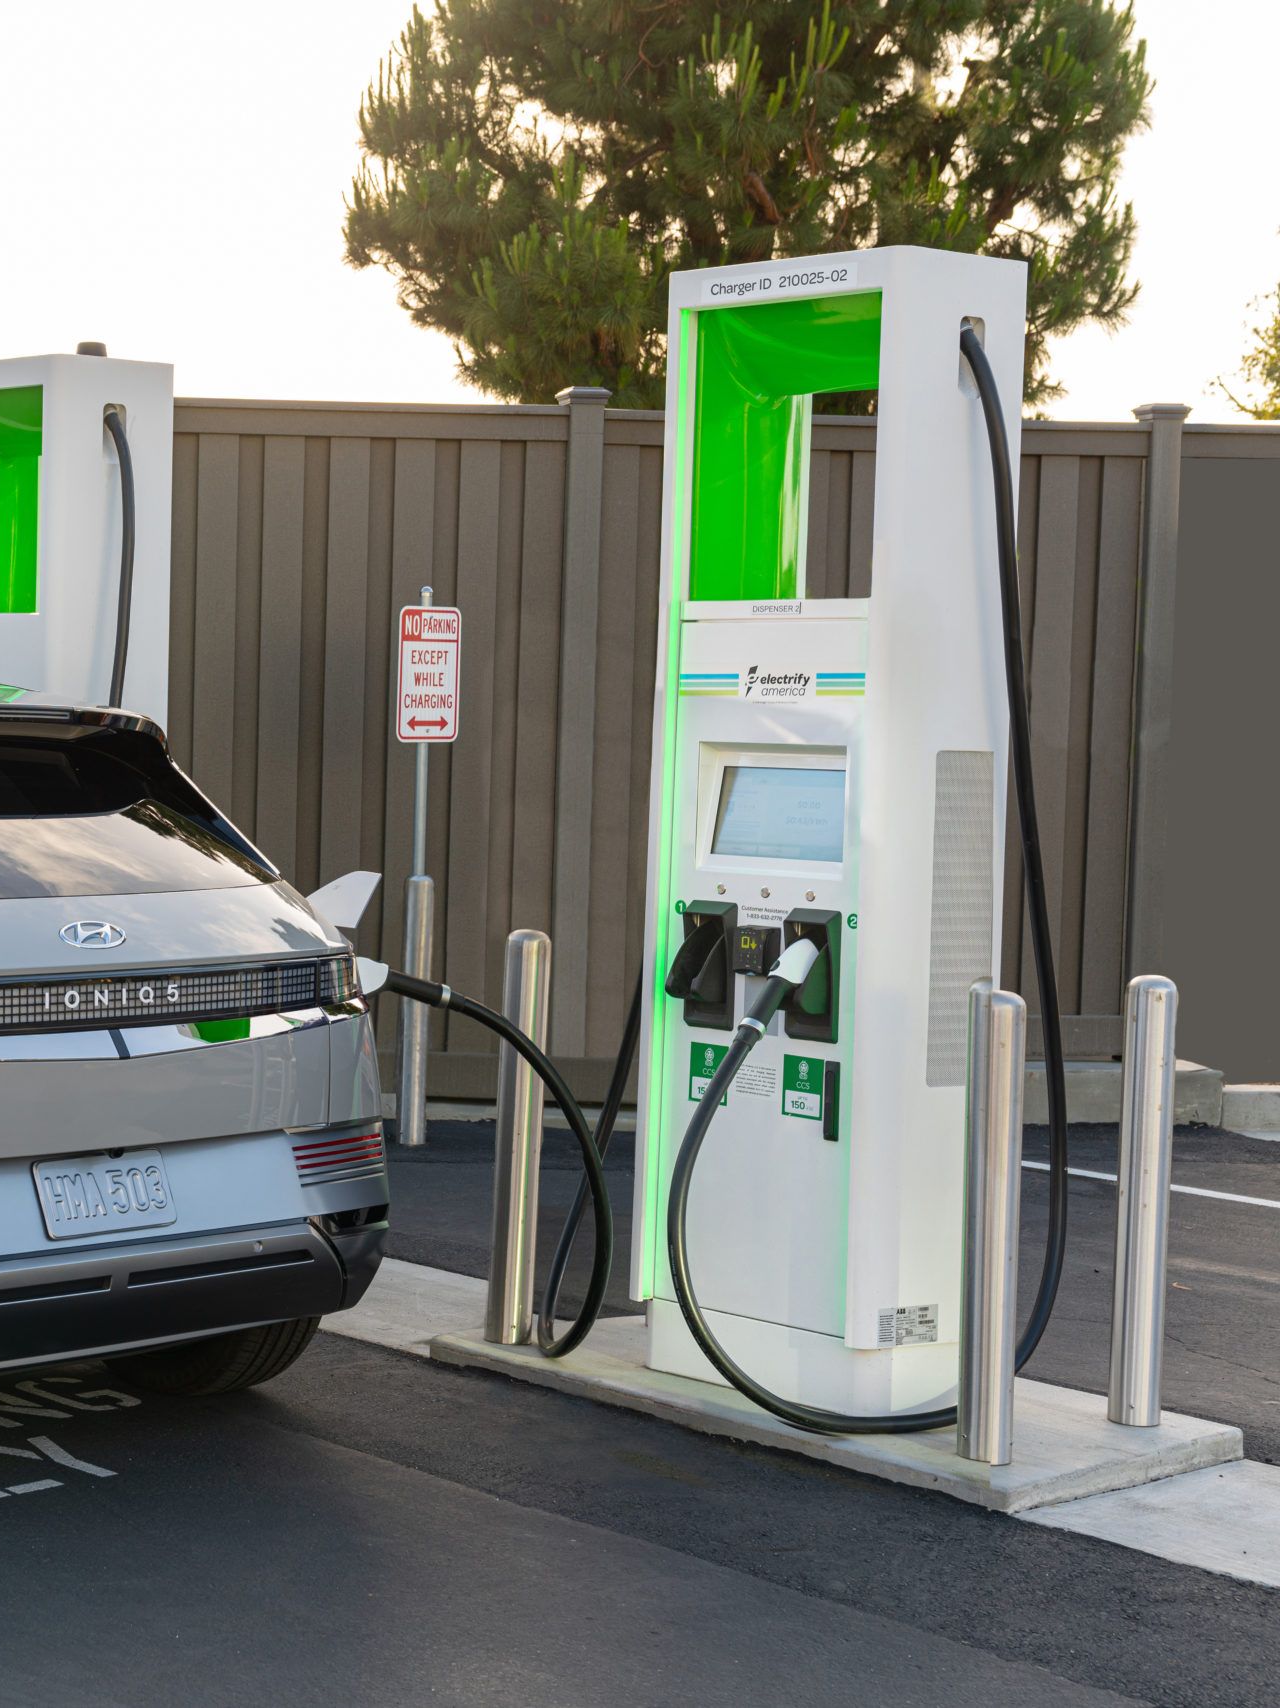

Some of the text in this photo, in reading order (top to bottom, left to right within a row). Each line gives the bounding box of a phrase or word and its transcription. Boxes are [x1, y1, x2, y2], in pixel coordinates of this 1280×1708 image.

[710, 269, 848, 296] Charger ID 210025-02
[404, 615, 456, 636] NO PARKING
[411, 650, 449, 665] EXCEPT
[414, 672, 445, 687] WHILE
[760, 673, 811, 687] electrify
[761, 686, 807, 697] america
[403, 693, 453, 709] CHARGING
[763, 907, 789, 915] Assistance
[44, 983, 180, 1010] IONIQ 5
[796, 1081, 811, 1090] CCS
[791, 1100, 806, 1110] 150
